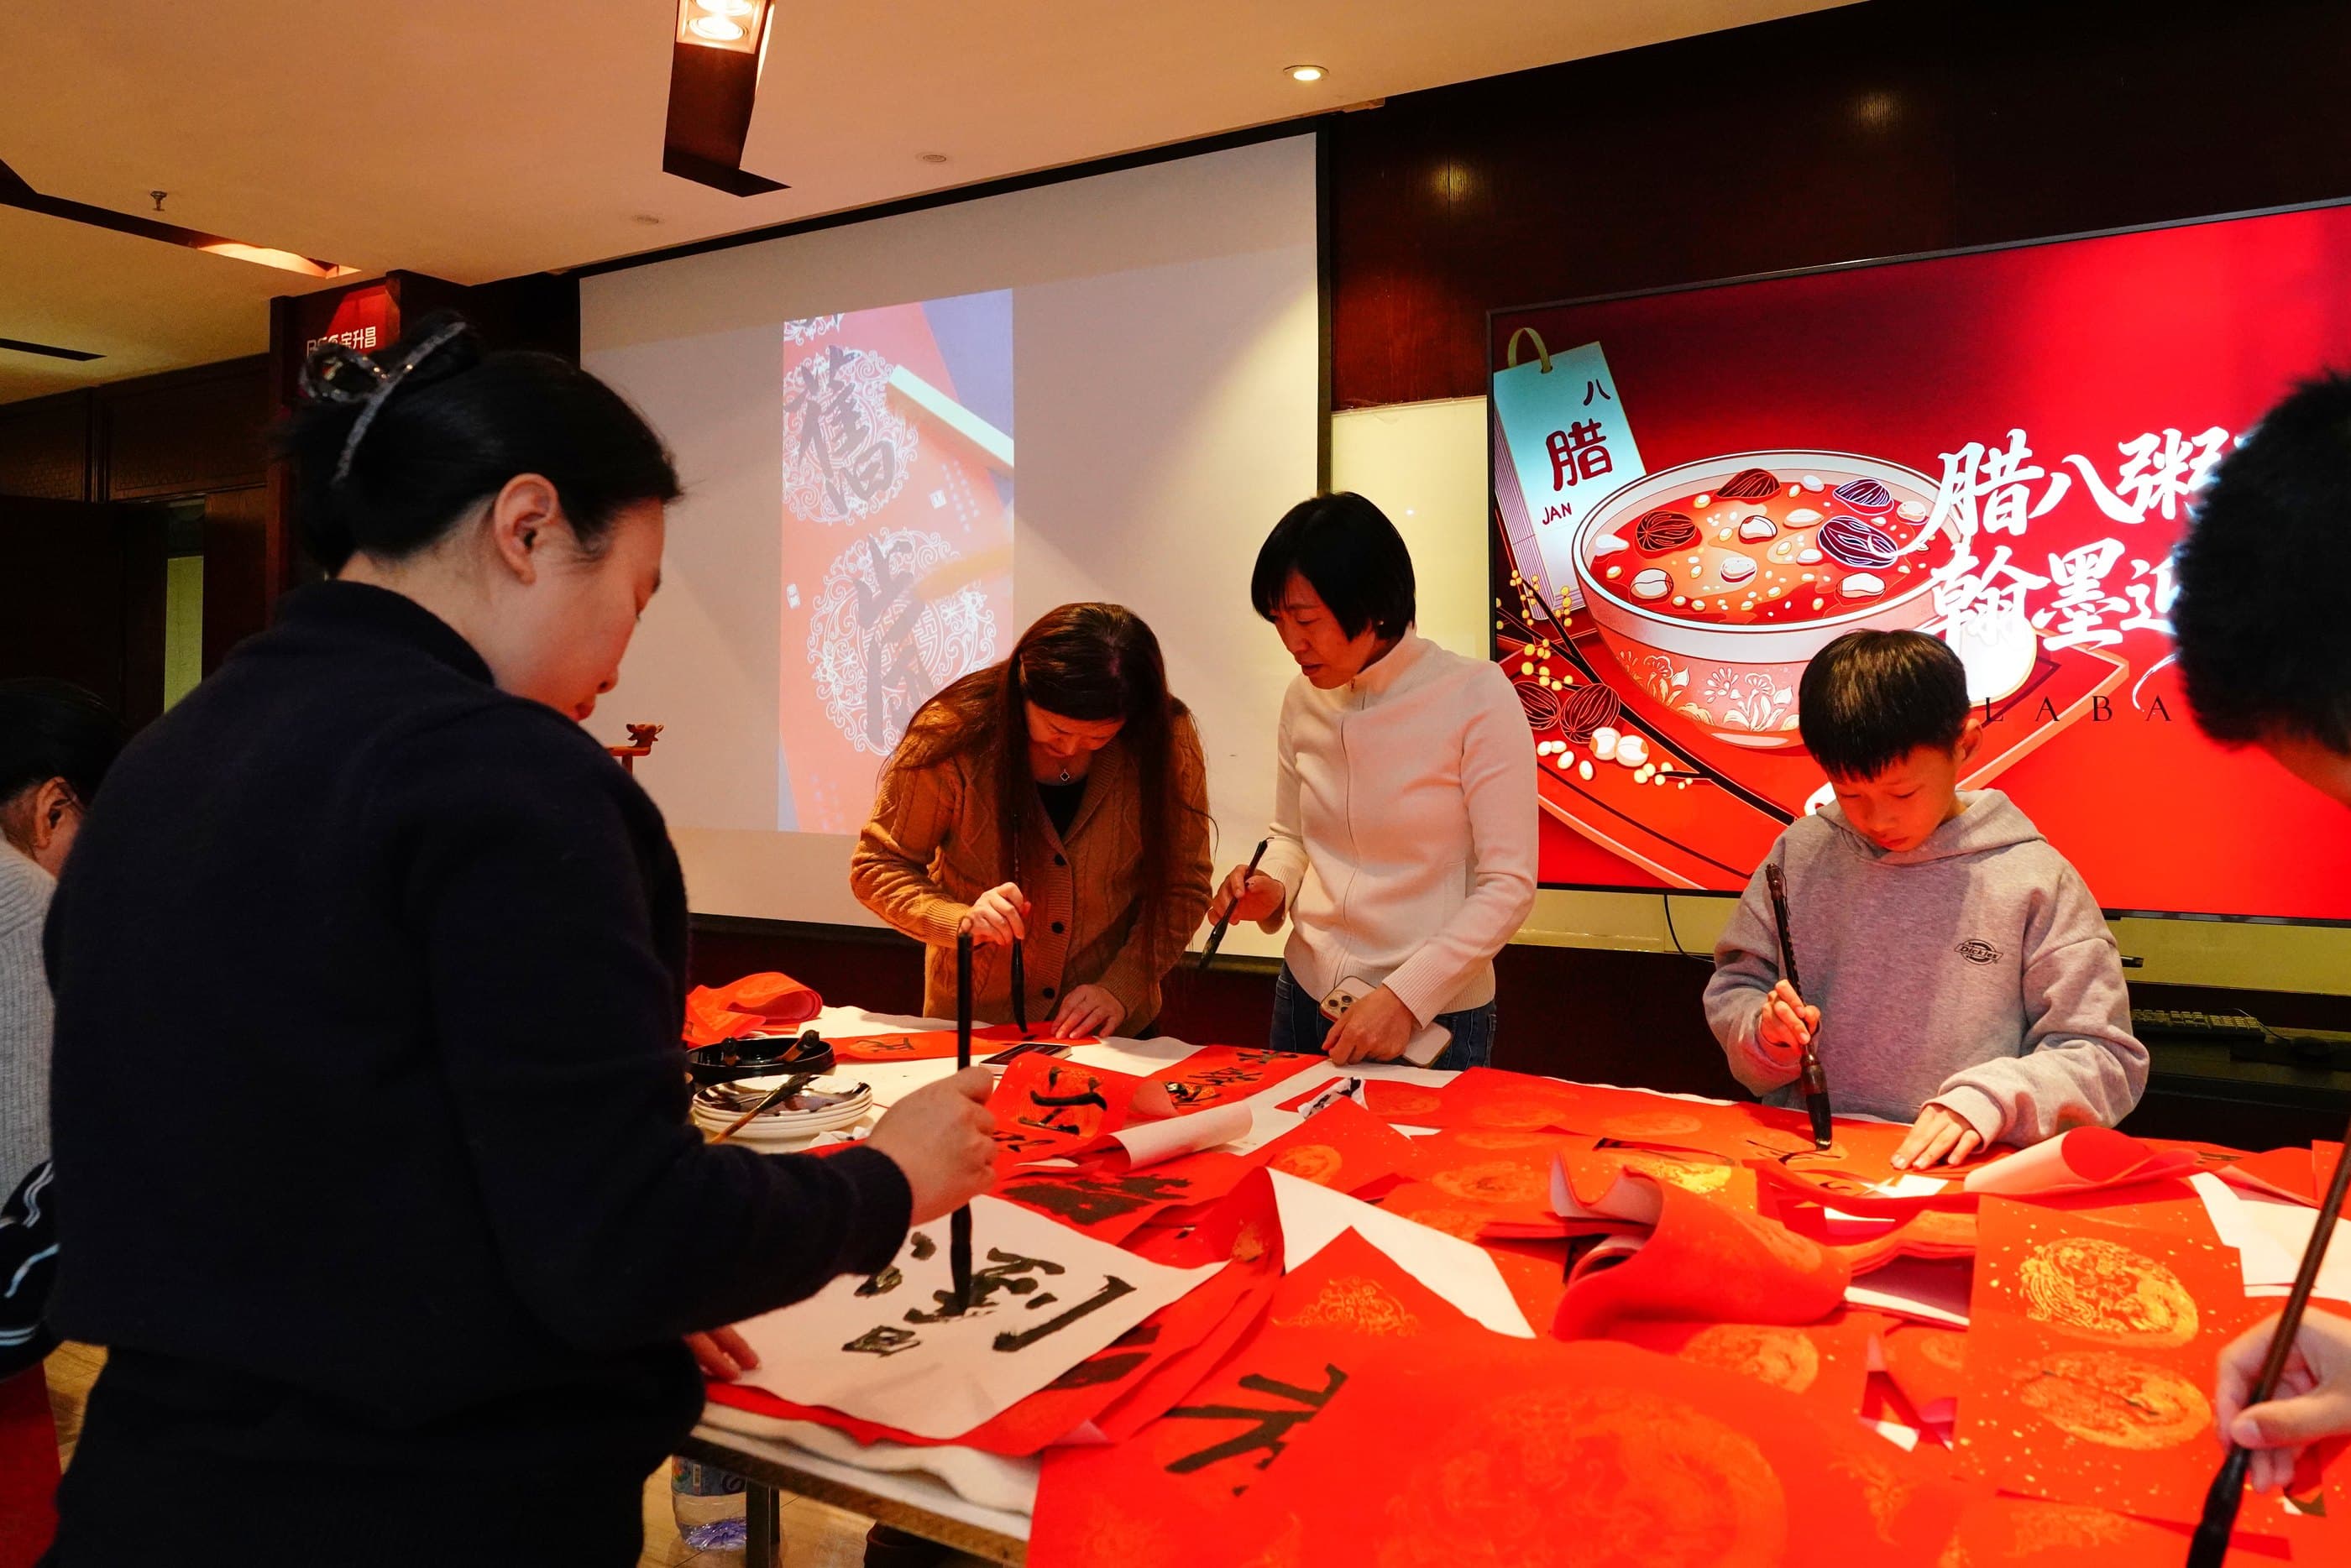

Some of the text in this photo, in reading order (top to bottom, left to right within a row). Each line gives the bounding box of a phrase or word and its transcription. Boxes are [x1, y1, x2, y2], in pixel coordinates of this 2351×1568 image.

[1583, 379, 1611, 406] 八
[1546, 418, 1613, 491] 腊
[1885, 426, 2252, 559] 腊八粥
[1542, 502, 1573, 525] JAN
[1959, 945, 1998, 959] Dickies
